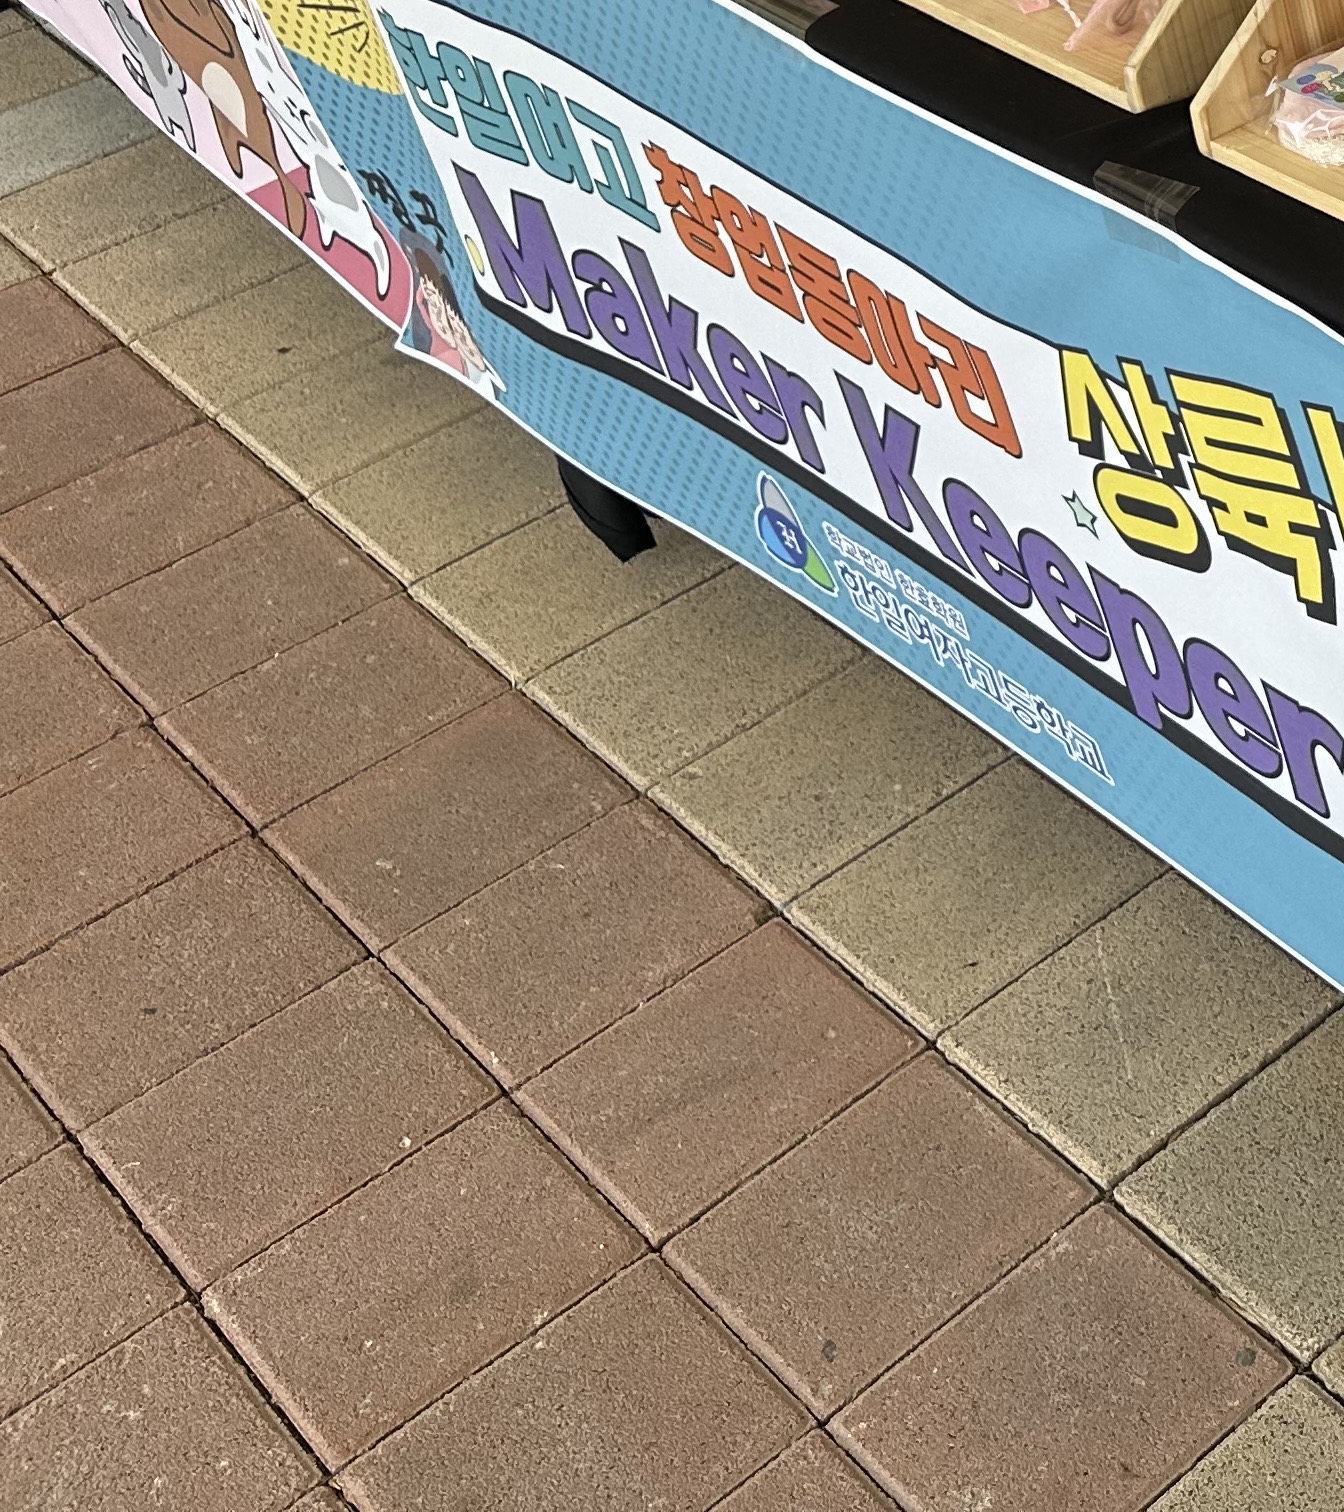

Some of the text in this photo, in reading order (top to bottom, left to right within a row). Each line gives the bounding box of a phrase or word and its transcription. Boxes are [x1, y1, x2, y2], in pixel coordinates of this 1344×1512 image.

[375, 6, 661, 232] 한일여고
[640, 140, 1023, 459] 창업동아리
[451, 160, 827, 475] Maker
[823, 521, 970, 640] 학교법인 한효학원
[834, 560, 1116, 786] 한일여자고등학교
